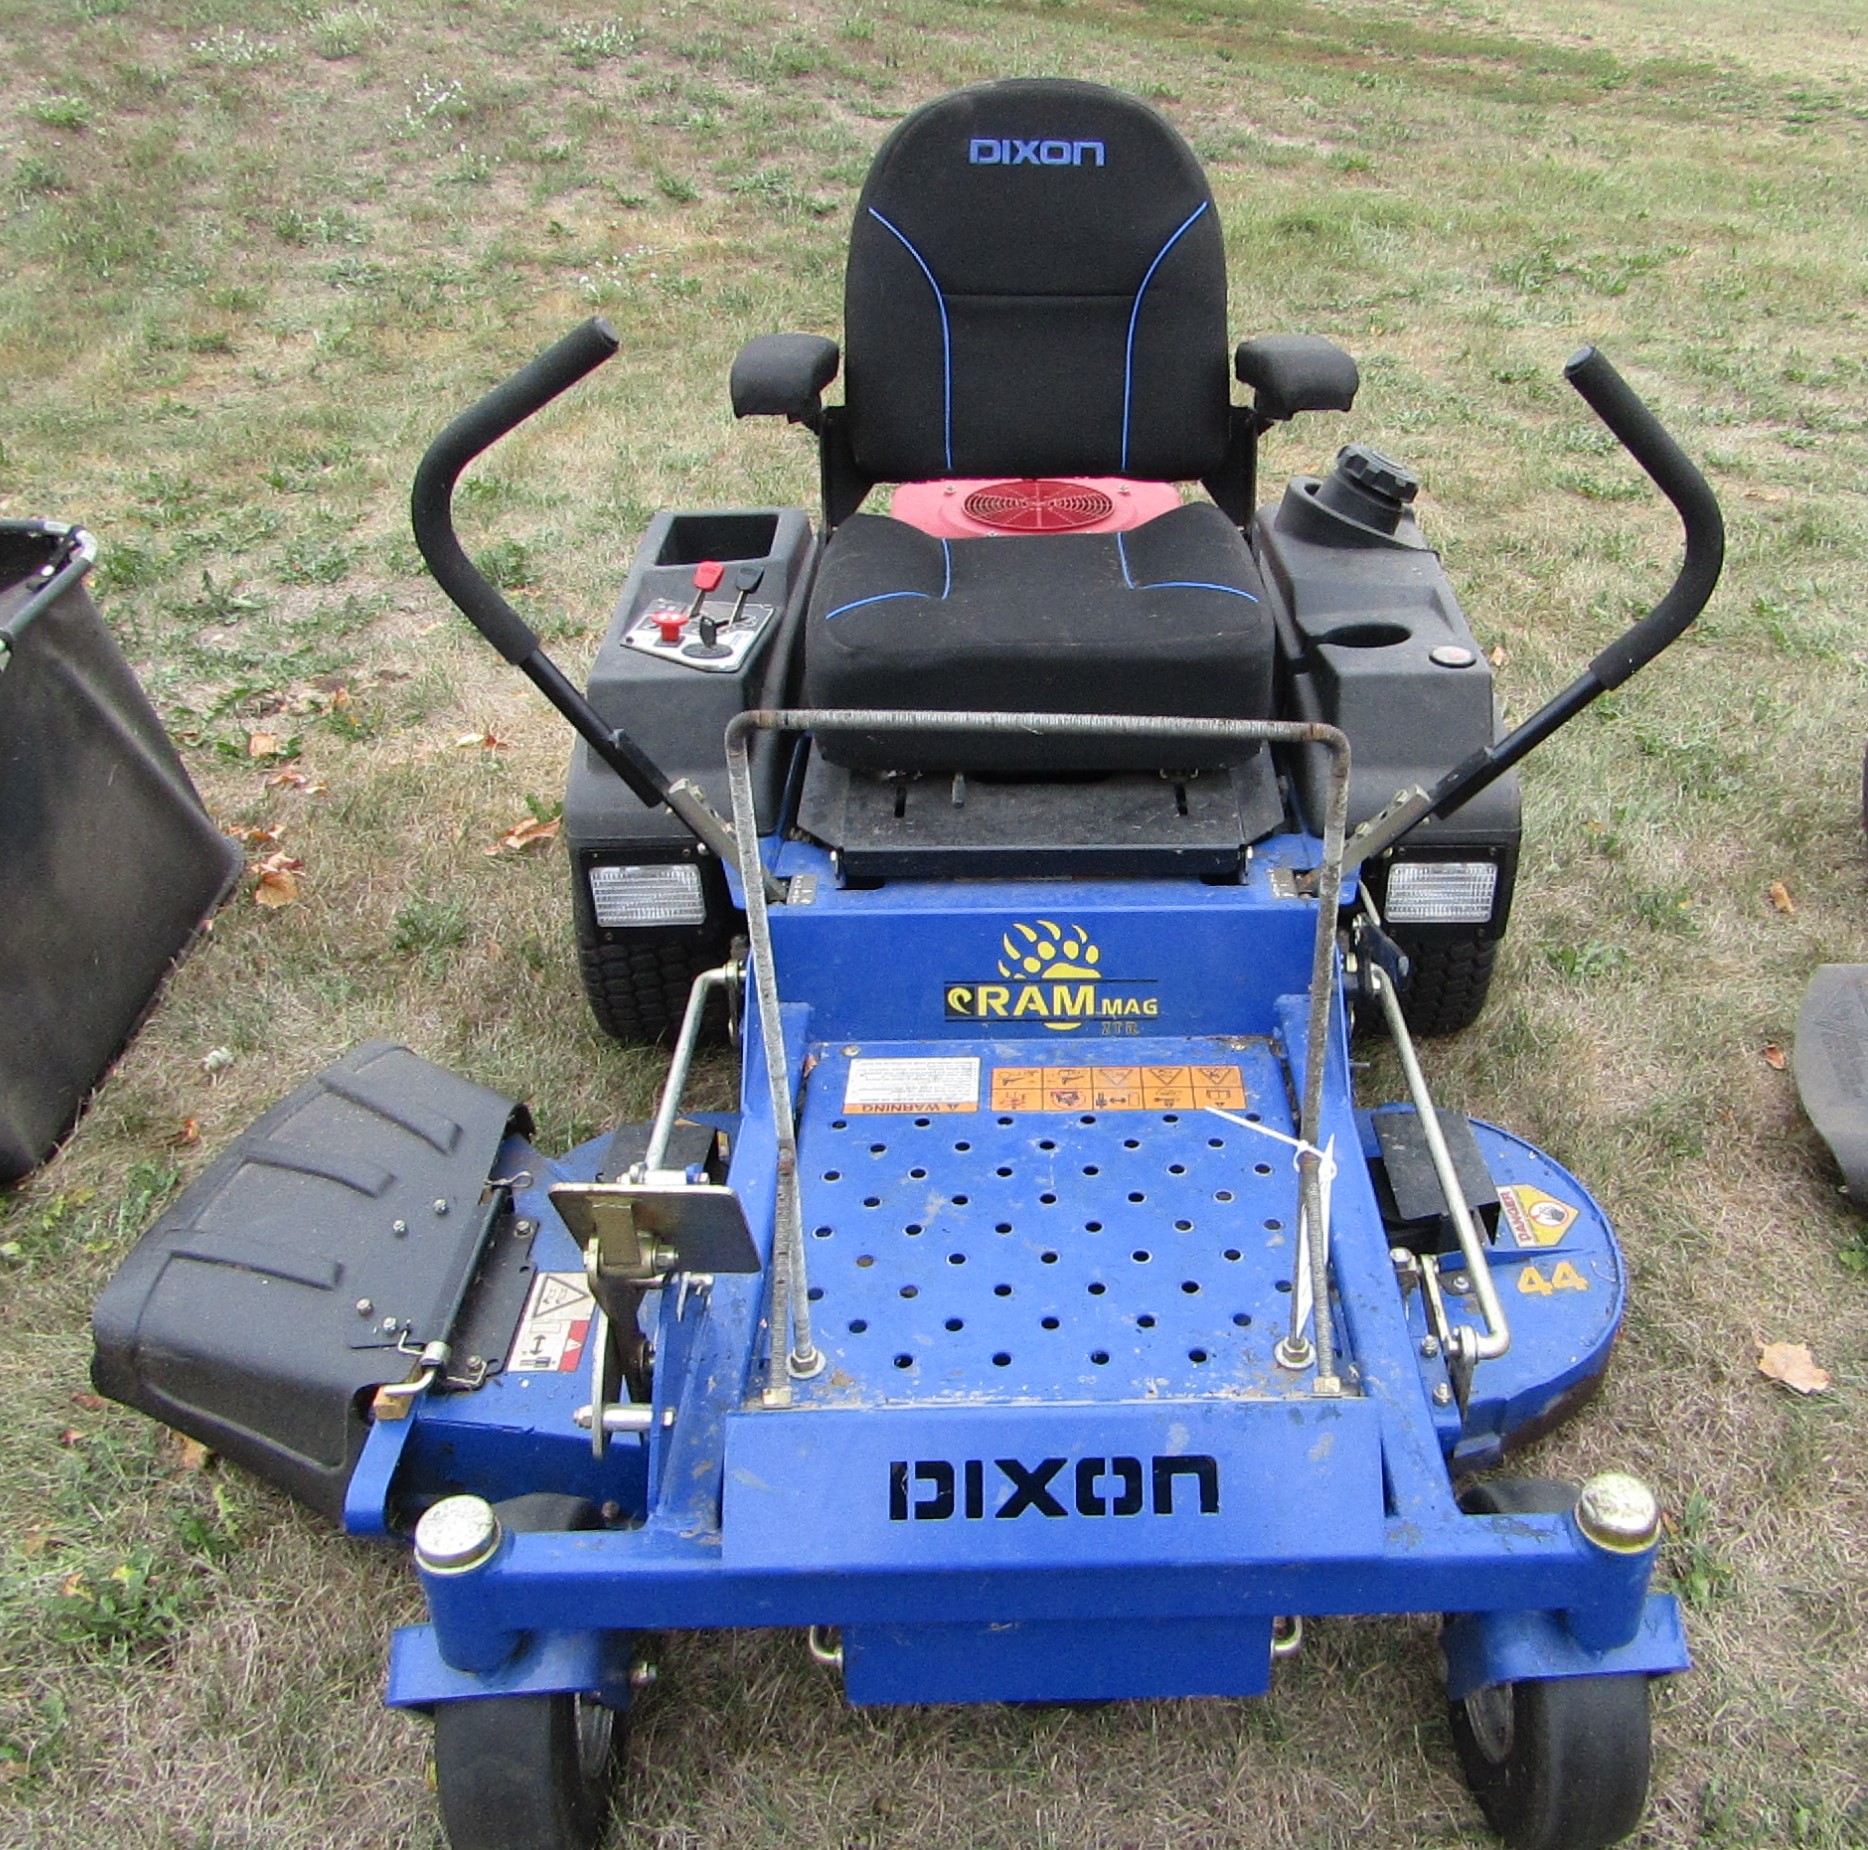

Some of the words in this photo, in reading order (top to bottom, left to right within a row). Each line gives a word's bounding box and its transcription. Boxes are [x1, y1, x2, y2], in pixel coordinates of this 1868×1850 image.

[968, 138, 1105, 167] DIXON
[977, 984, 1095, 1017] RAM
[1101, 998, 1159, 1016] MAG
[862, 1103, 940, 1113] WARNING
[1498, 1190, 1532, 1243] DANGER
[1517, 1260, 1589, 1296] 44
[889, 1454, 1220, 1521] DIXON
